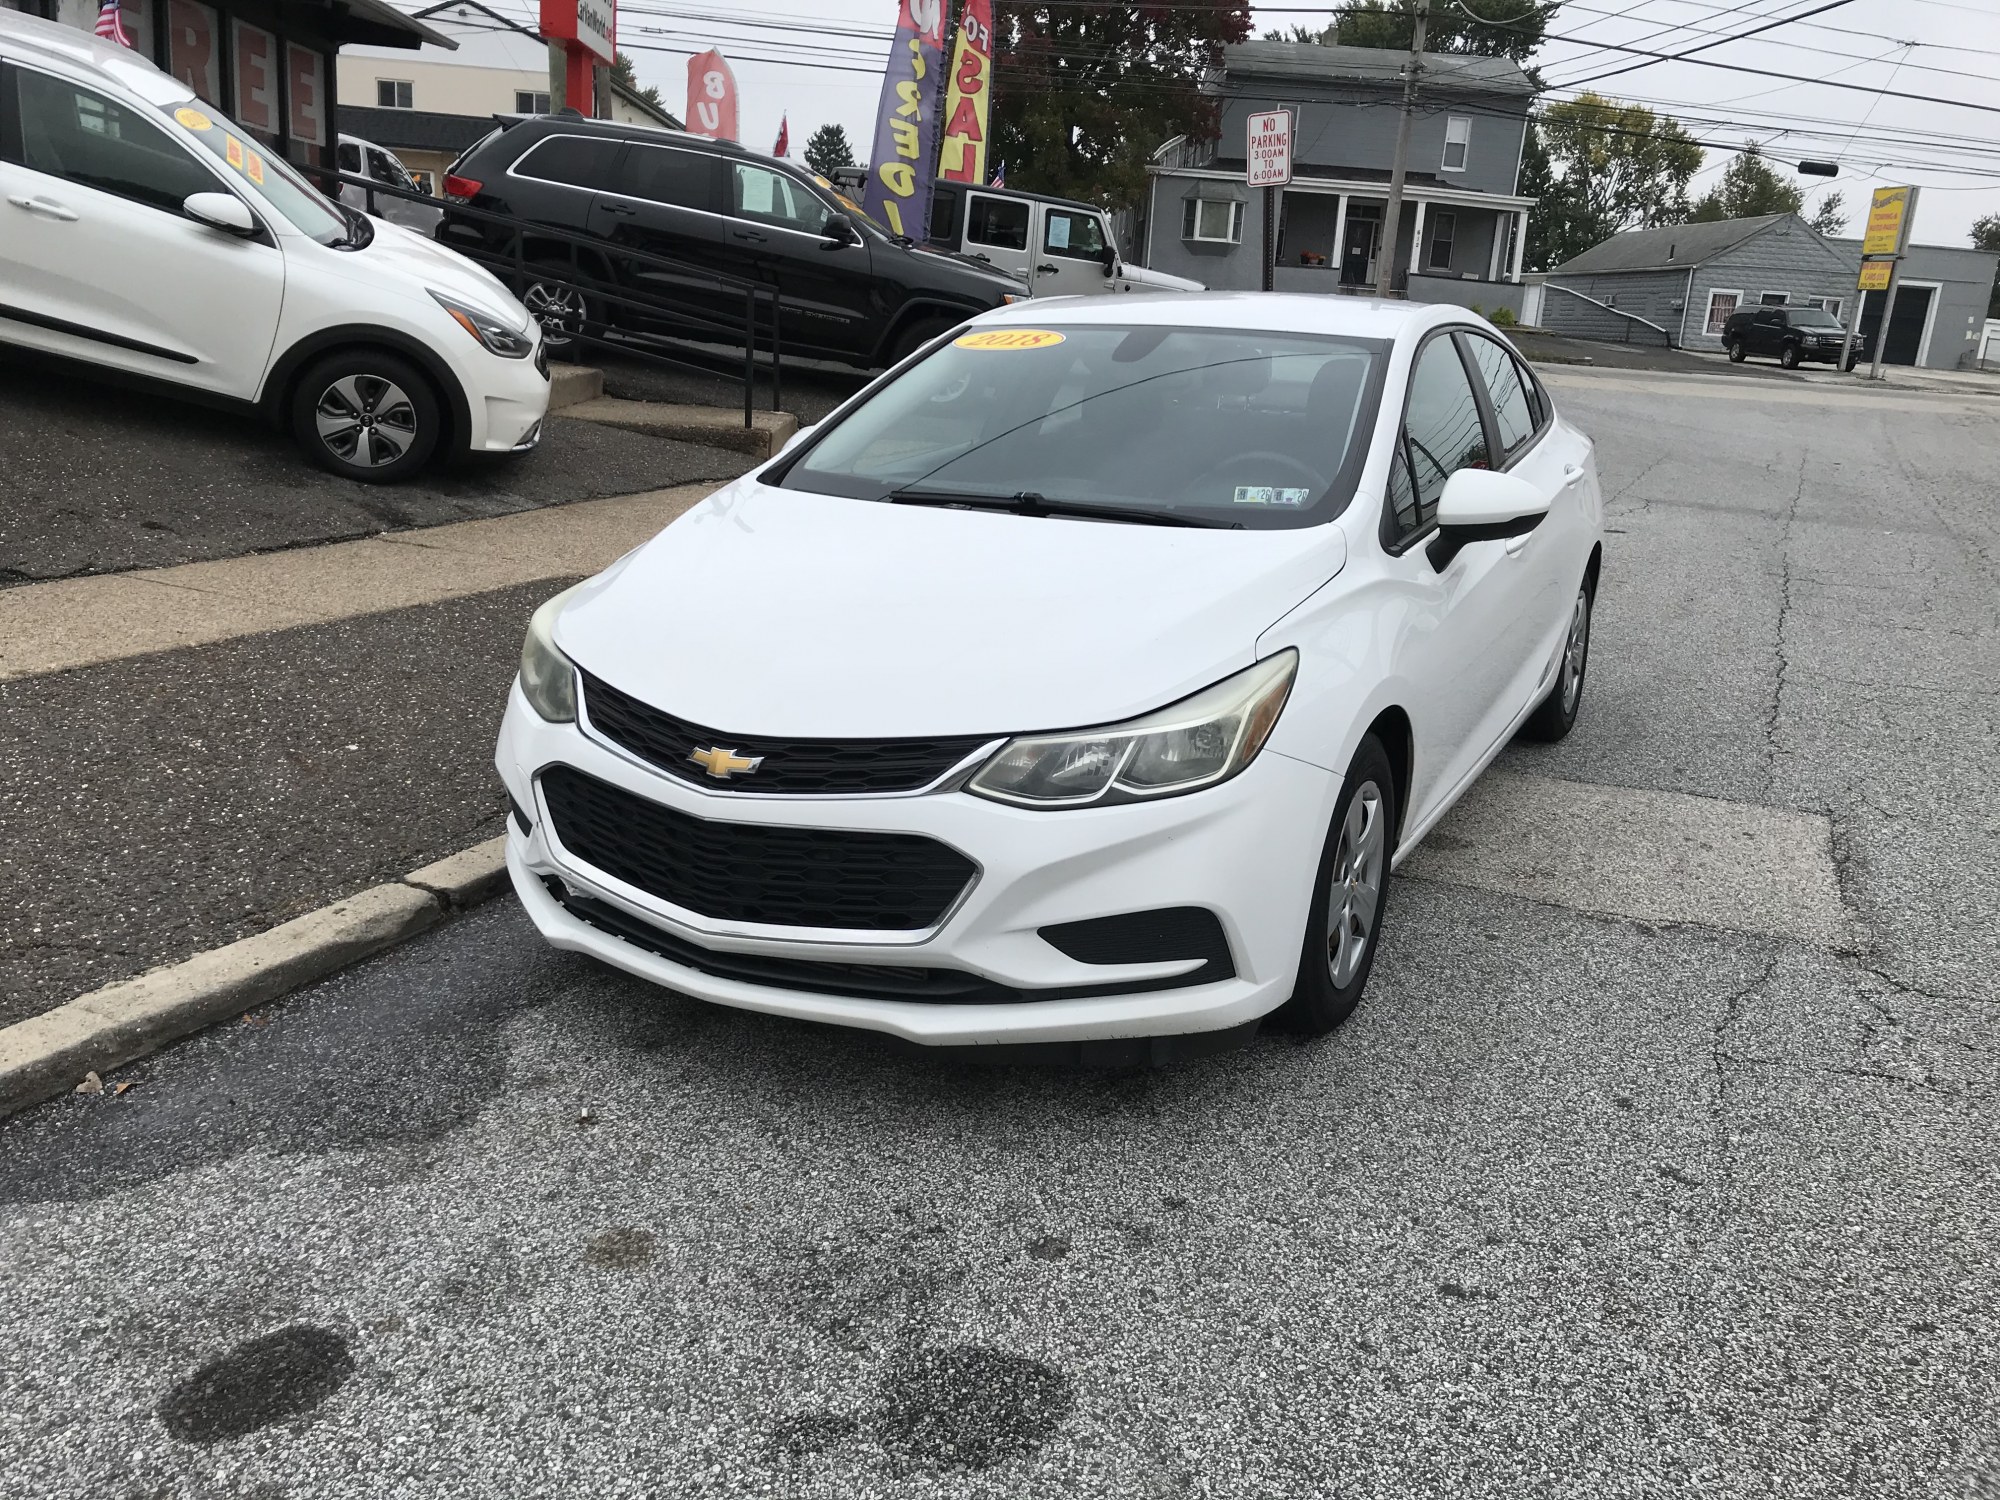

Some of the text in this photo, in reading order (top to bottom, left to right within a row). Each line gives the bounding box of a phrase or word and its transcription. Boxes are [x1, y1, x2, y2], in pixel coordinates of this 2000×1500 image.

[1262, 118, 1276, 133] NO
[1251, 132, 1287, 150] PARKING
[1254, 148, 1284, 160] 3:00AM
[1263, 159, 1274, 169] TO
[1253, 168, 1284, 180] 6:00AM
[965, 333, 1052, 347] 2018
